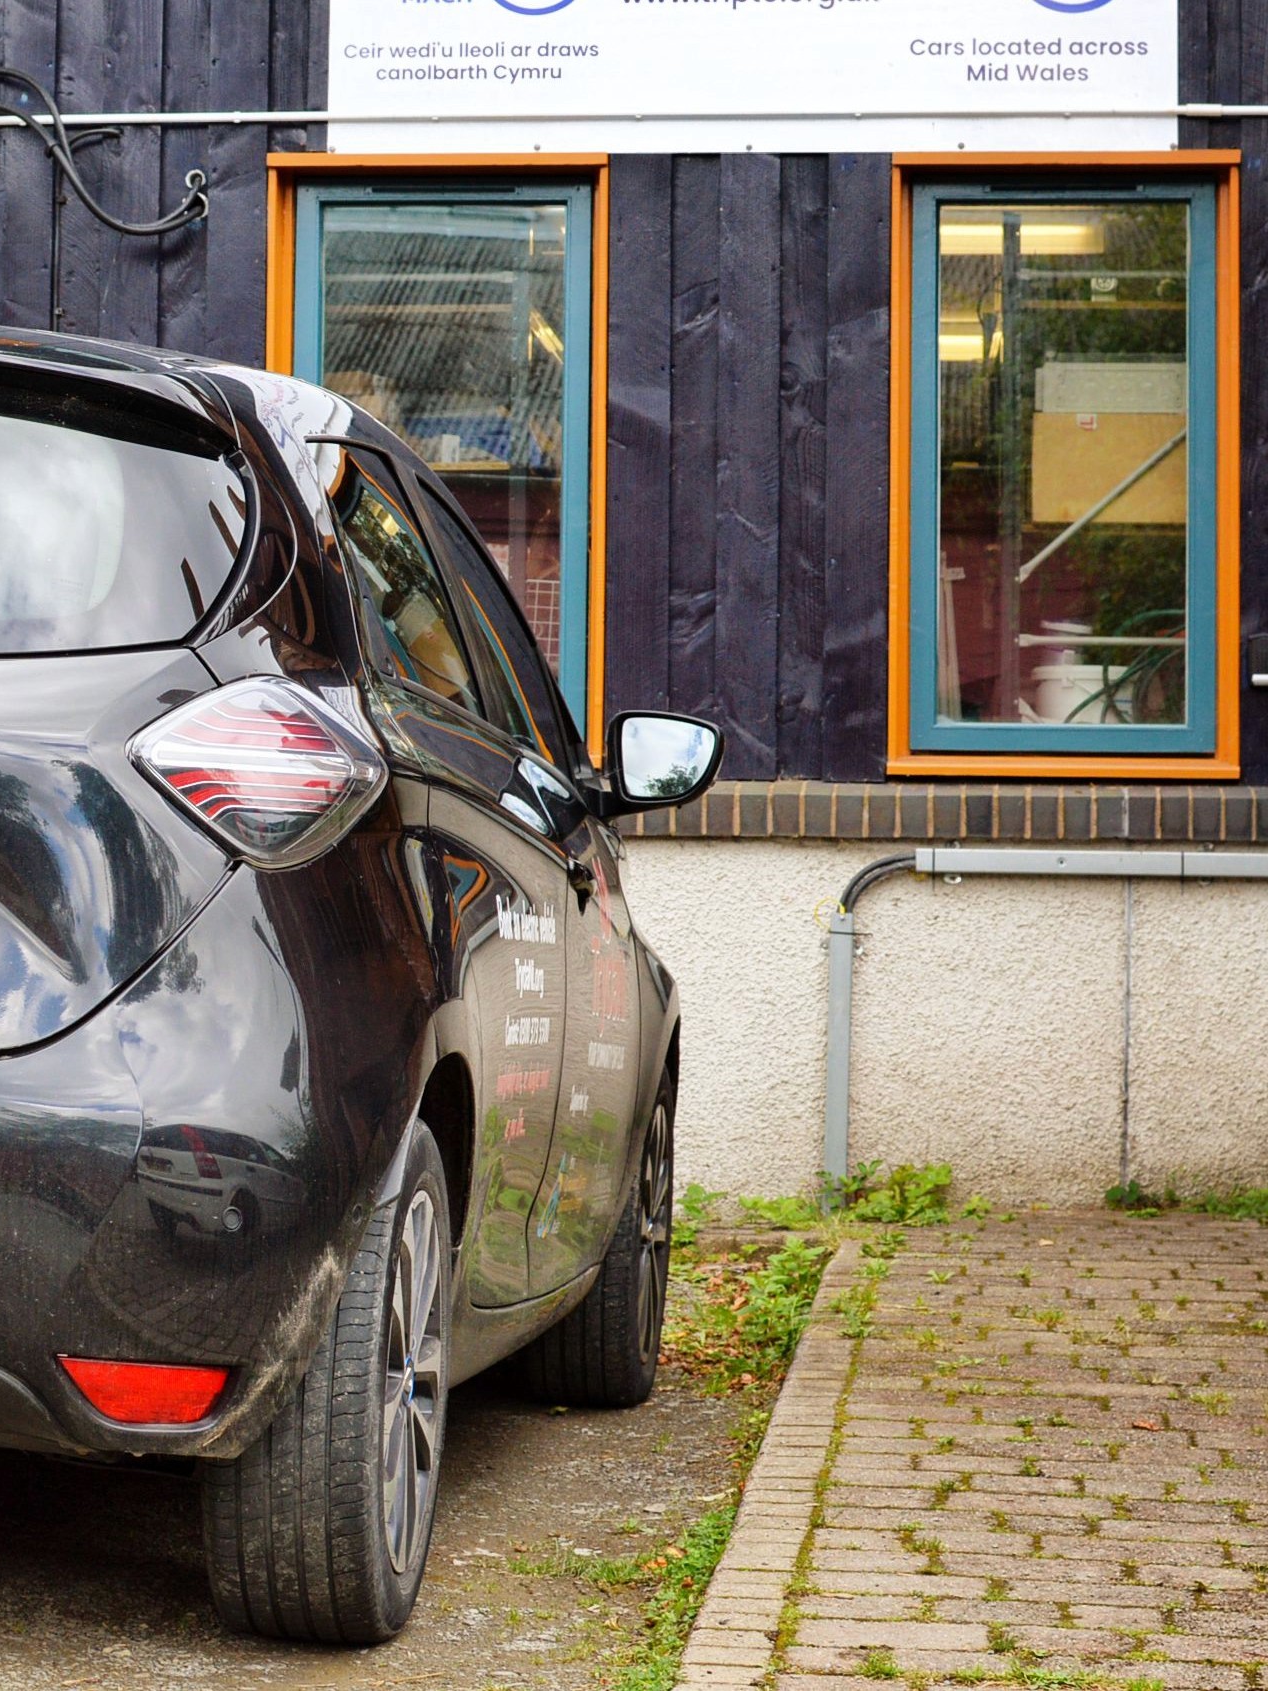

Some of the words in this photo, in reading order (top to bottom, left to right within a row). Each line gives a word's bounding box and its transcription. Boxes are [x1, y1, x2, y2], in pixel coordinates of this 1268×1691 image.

[343, 42, 384, 59] Ceir
[389, 41, 453, 59] wedi'u
[458, 41, 506, 58] lleoli
[510, 45, 532, 58] ar
[536, 41, 600, 57] draws
[909, 38, 965, 56] Cars
[972, 37, 1062, 56] located
[1068, 40, 1149, 56] across
[375, 64, 488, 81] canolbarth
[493, 64, 563, 84] Cymru
[966, 63, 1009, 82] Mid
[1016, 63, 1089, 82] Wales
